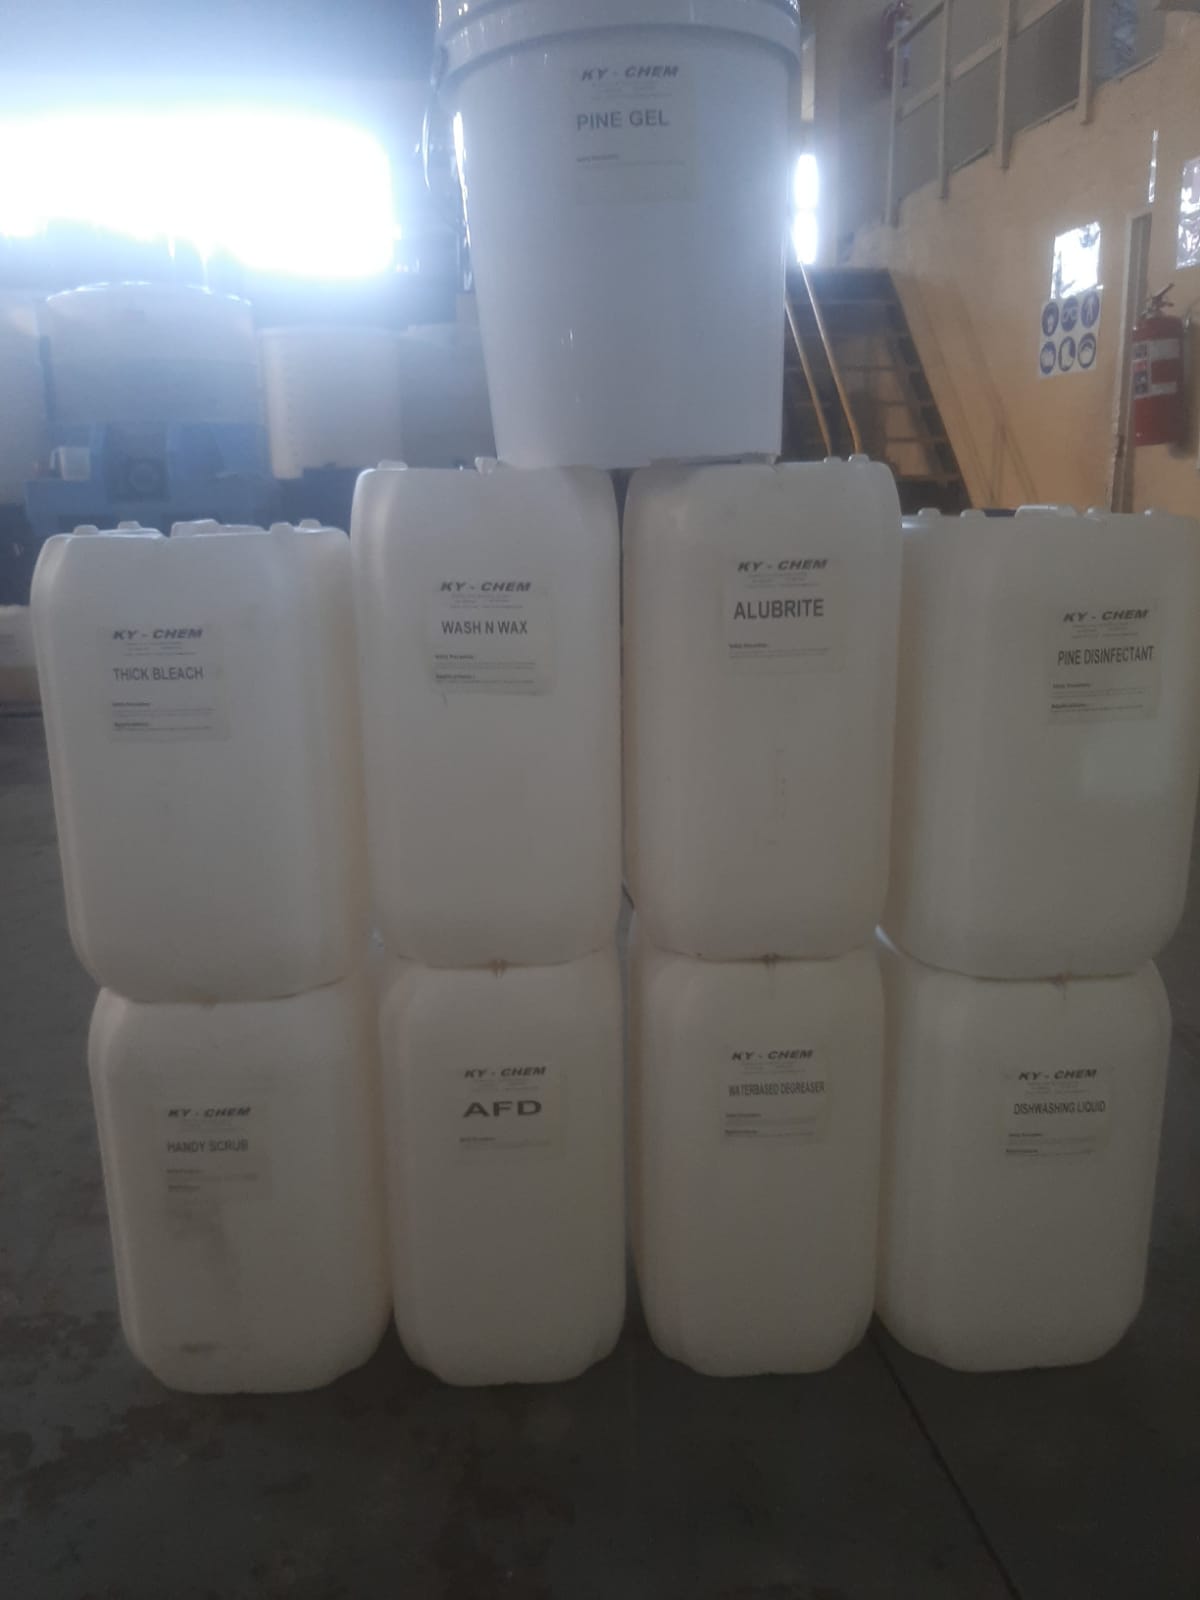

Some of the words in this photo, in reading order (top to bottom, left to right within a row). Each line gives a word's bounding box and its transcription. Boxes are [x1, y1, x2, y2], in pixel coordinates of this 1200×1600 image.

[582, 67, 608, 81] KY
[624, 64, 679, 79] CHEM
[576, 111, 622, 130] PINE
[629, 108, 670, 127] GEL
[738, 560, 764, 573] KY
[778, 558, 828, 571] CHEM
[440, 581, 466, 592] KY
[481, 580, 532, 592] CHEM
[734, 598, 825, 620] ALUBRITE
[1063, 611, 1089, 622] KY
[1102, 608, 1149, 621] CHEM
[112, 629, 139, 640] KY
[153, 628, 203, 640] CHEM
[441, 620, 481, 634] WASH
[485, 620, 495, 634] N
[498, 620, 528, 634] WAX
[1057, 648, 1081, 666] PINE
[1084, 645, 1155, 665] DISINFECTANT
[112, 666, 150, 681] THICK
[152, 666, 205, 681] BLEACH
[731, 1050, 756, 1061] KY
[767, 1048, 814, 1060] CHEM
[464, 1068, 487, 1079] KY
[501, 1066, 546, 1078] CHEM
[1018, 1071, 1041, 1081] KY
[1054, 1068, 1097, 1080] CHEM
[463, 1100, 542, 1118] AFD
[1013, 1101, 1076, 1115] DISHWASHING
[167, 1140, 205, 1153] HANDY
